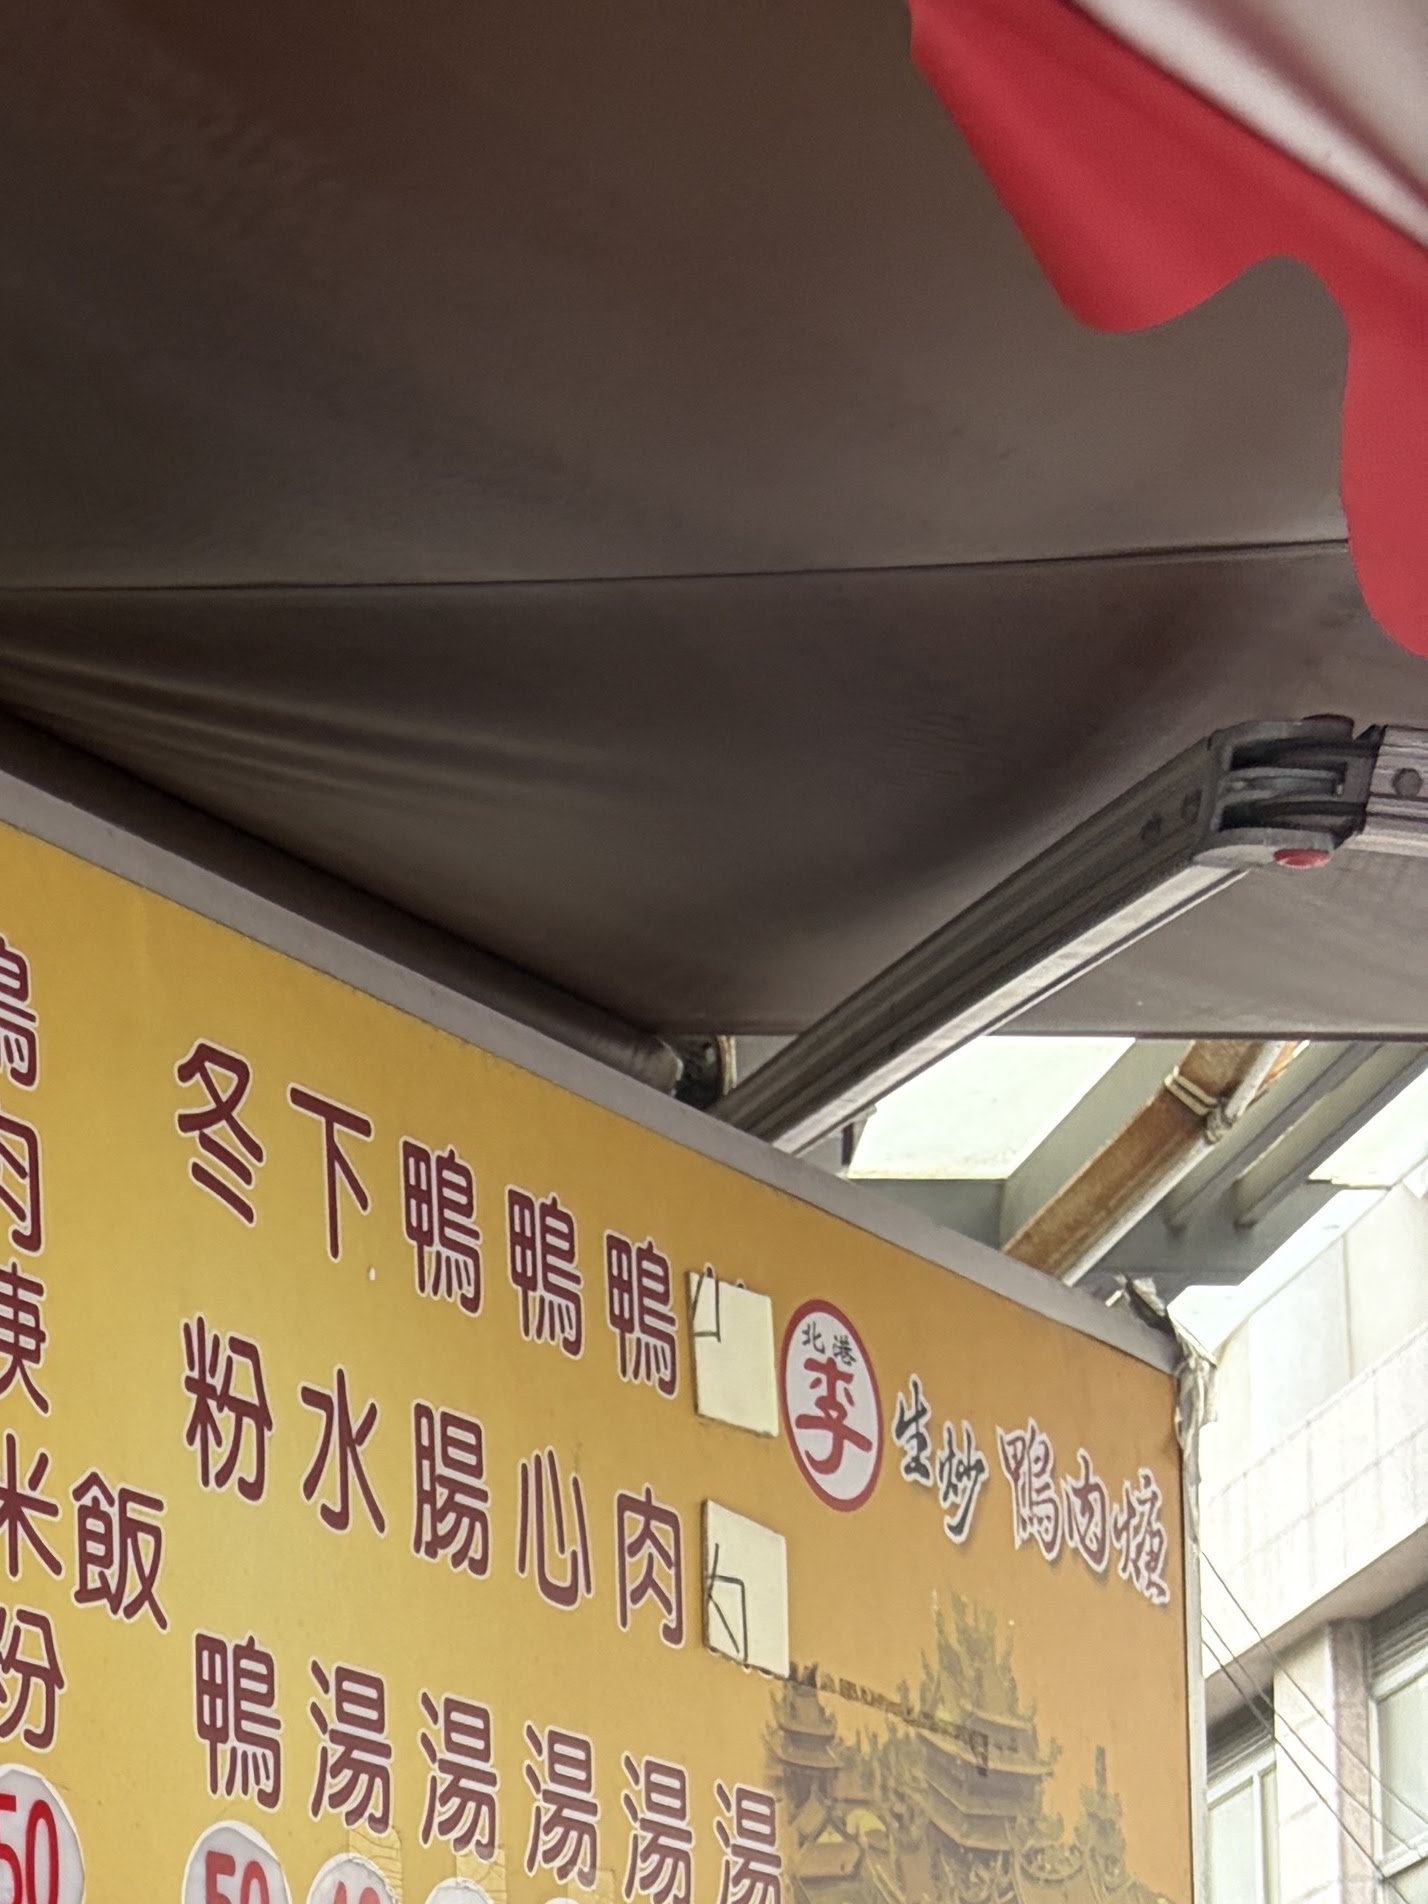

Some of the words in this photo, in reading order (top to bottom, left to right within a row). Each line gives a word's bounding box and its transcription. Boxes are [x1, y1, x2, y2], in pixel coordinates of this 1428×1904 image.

[71, 1469, 169, 1633] 飯
[174, 1038, 282, 1810] 冬粉鴨
[287, 1083, 393, 1835] 下水湯
[400, 1137, 499, 1862] 鴨腸湯
[505, 1185, 599, 1889] 鴨心湯
[801, 1321, 857, 1367] 北港
